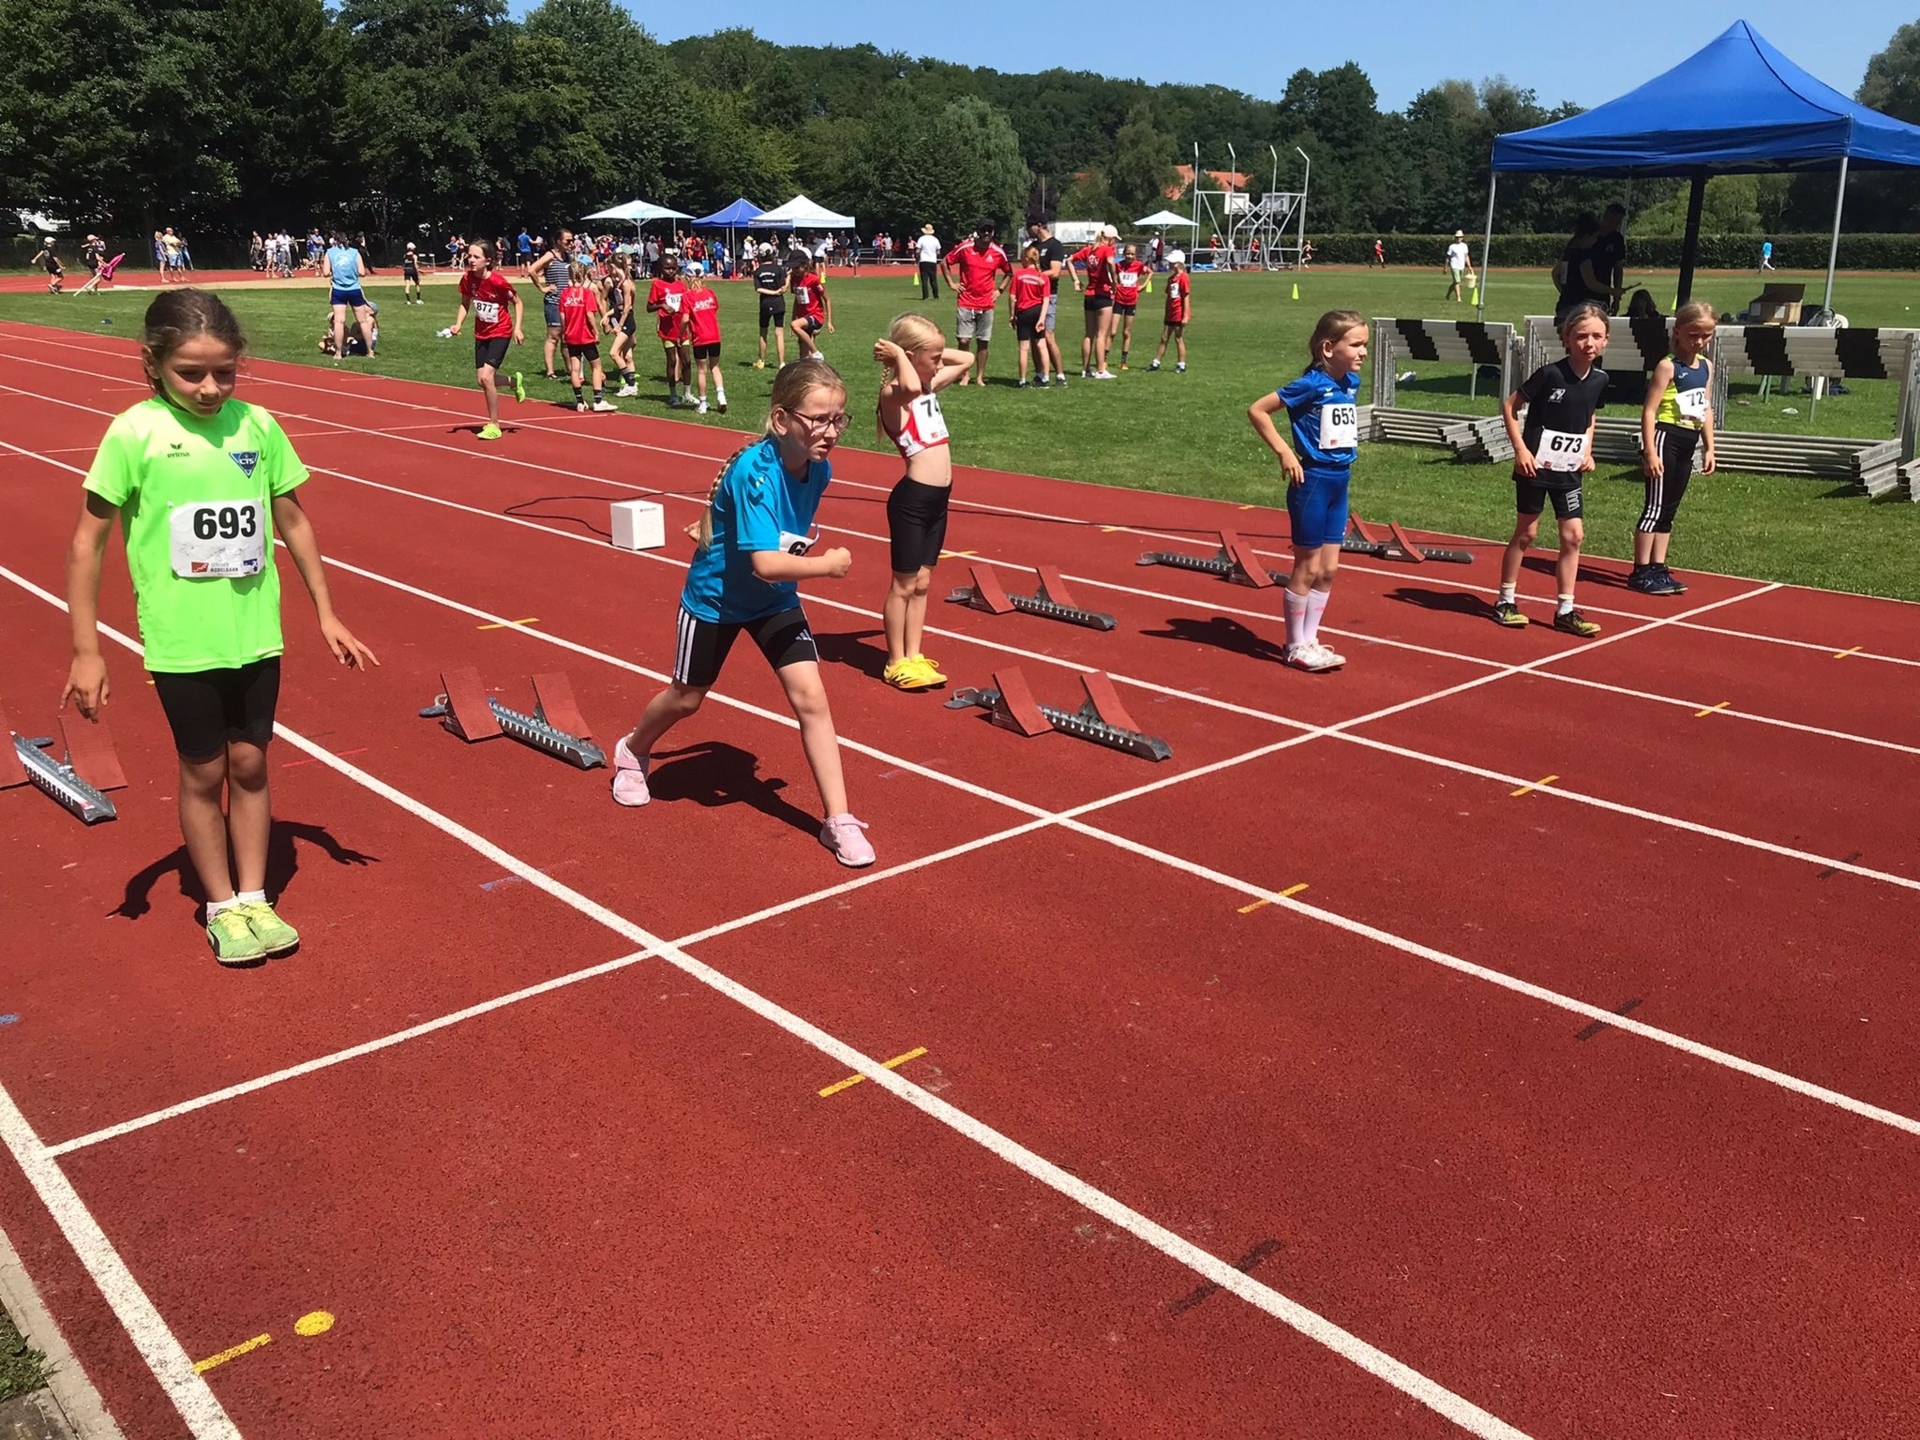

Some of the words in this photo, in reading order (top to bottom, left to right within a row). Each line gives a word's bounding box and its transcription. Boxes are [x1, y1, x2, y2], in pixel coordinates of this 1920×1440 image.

[476, 302, 493, 313] 877
[1685, 390, 1706, 407] 72
[1332, 407, 1356, 426] 653
[1550, 435, 1583, 454] 673
[193, 504, 256, 540] 693
